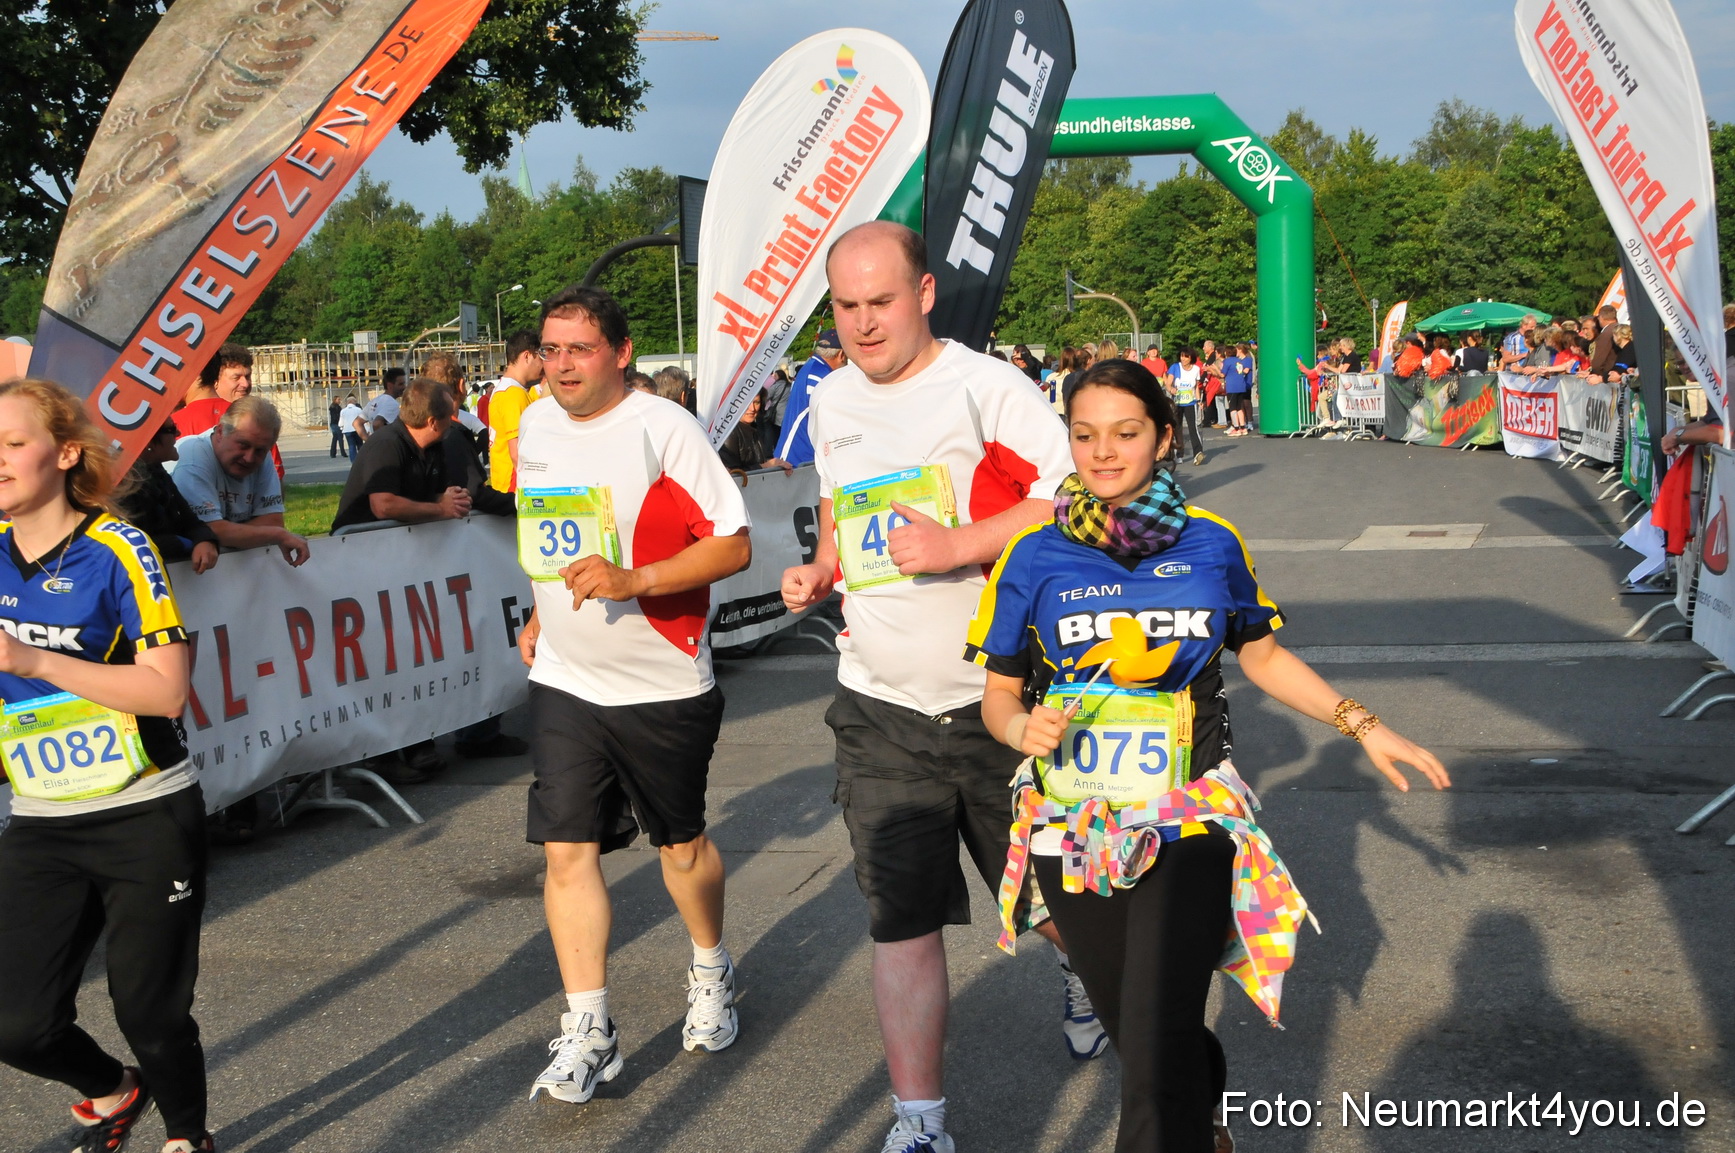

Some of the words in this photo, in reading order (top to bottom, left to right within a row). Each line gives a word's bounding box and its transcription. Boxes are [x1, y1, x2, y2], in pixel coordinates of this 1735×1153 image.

[1028, 61, 1050, 117] SWEDEN
[772, 83, 849, 192] Frischmann
[945, 29, 1055, 276] THULE
[742, 213, 822, 305] Print
[794, 84, 904, 221] Factory
[1210, 135, 1293, 204] AOK
[98, 24, 425, 451] CHSELSZENE.DE
[97, 520, 171, 605] BOCK
[538, 519, 581, 557] 39
[542, 558, 566, 567] Achim
[1058, 583, 1122, 603] TEAM
[187, 573, 475, 732] XL-PRINT
[10, 725, 124, 779] 1082
[1052, 729, 1169, 775] 1075
[43, 777, 70, 790] Elisa
[1073, 778, 1105, 791] Anna
